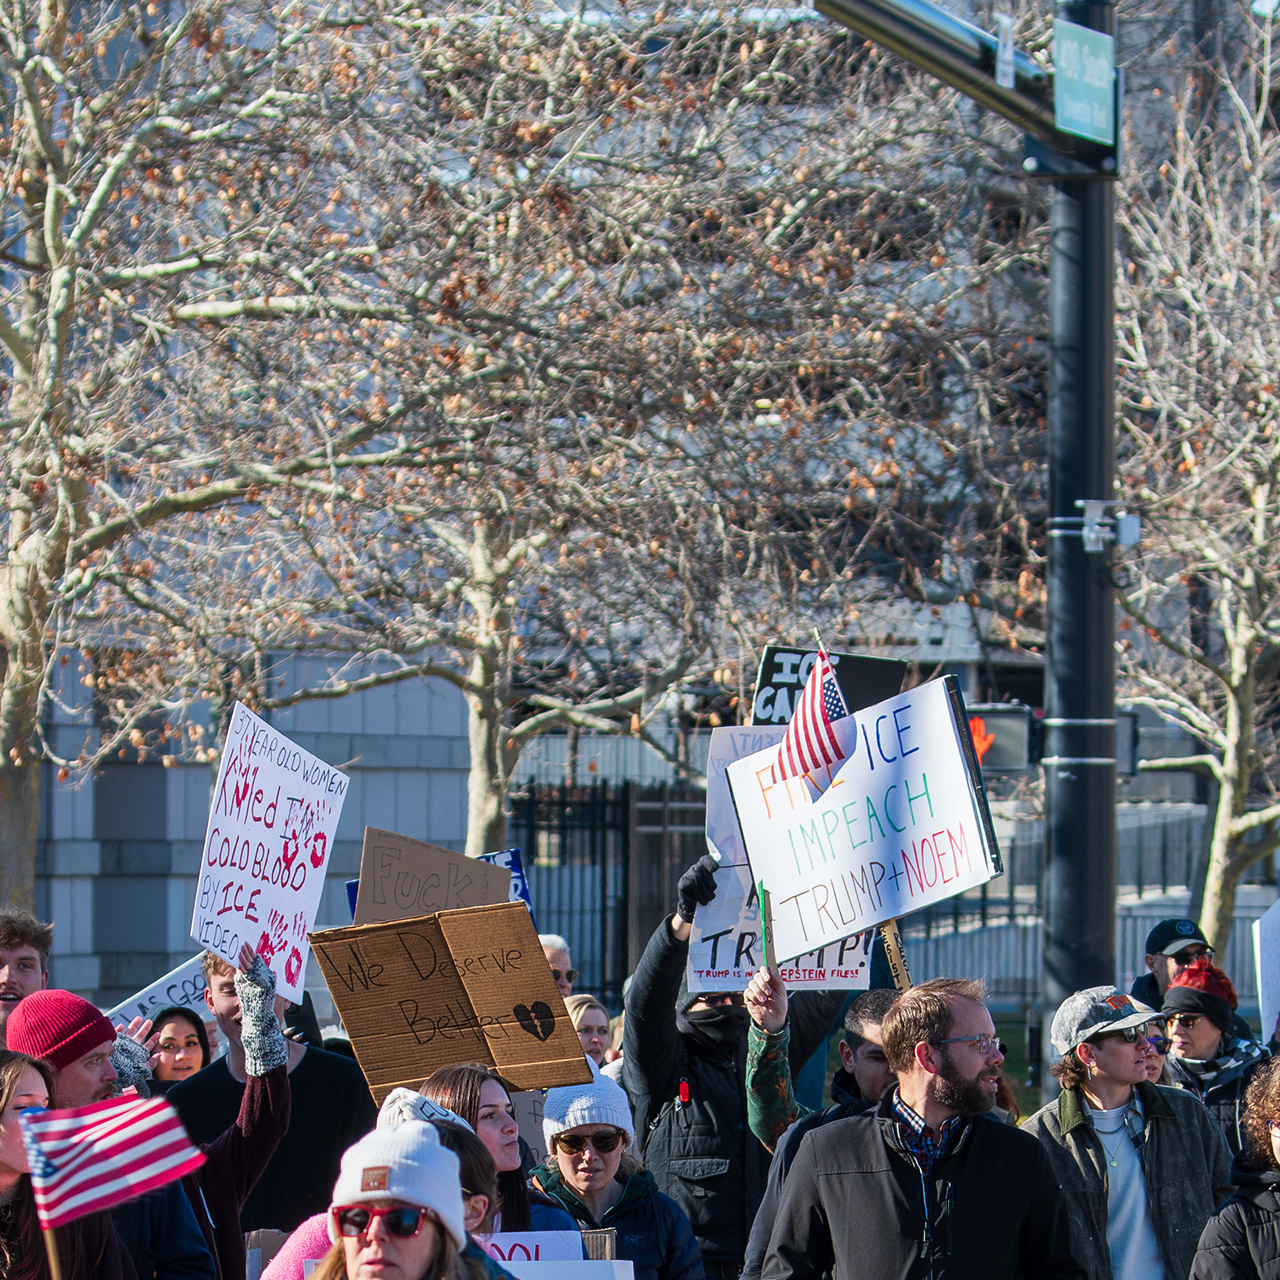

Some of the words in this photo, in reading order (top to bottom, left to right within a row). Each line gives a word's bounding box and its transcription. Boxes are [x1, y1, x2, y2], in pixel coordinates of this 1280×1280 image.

[861, 705, 920, 771] ICE
[277, 742, 301, 774] OLD
[301, 752, 347, 796] WOMEN
[206, 827, 251, 871] COLD
[787, 772, 935, 876] IMPEACH
[200, 874, 220, 915] BY
[217, 880, 261, 924] ICE
[196, 916, 240, 961] VIDEO
[319, 942, 389, 992] We
[396, 930, 522, 982] Deserve
[780, 968, 827, 981] EPSTEIN
[398, 1000, 512, 1045] Better
